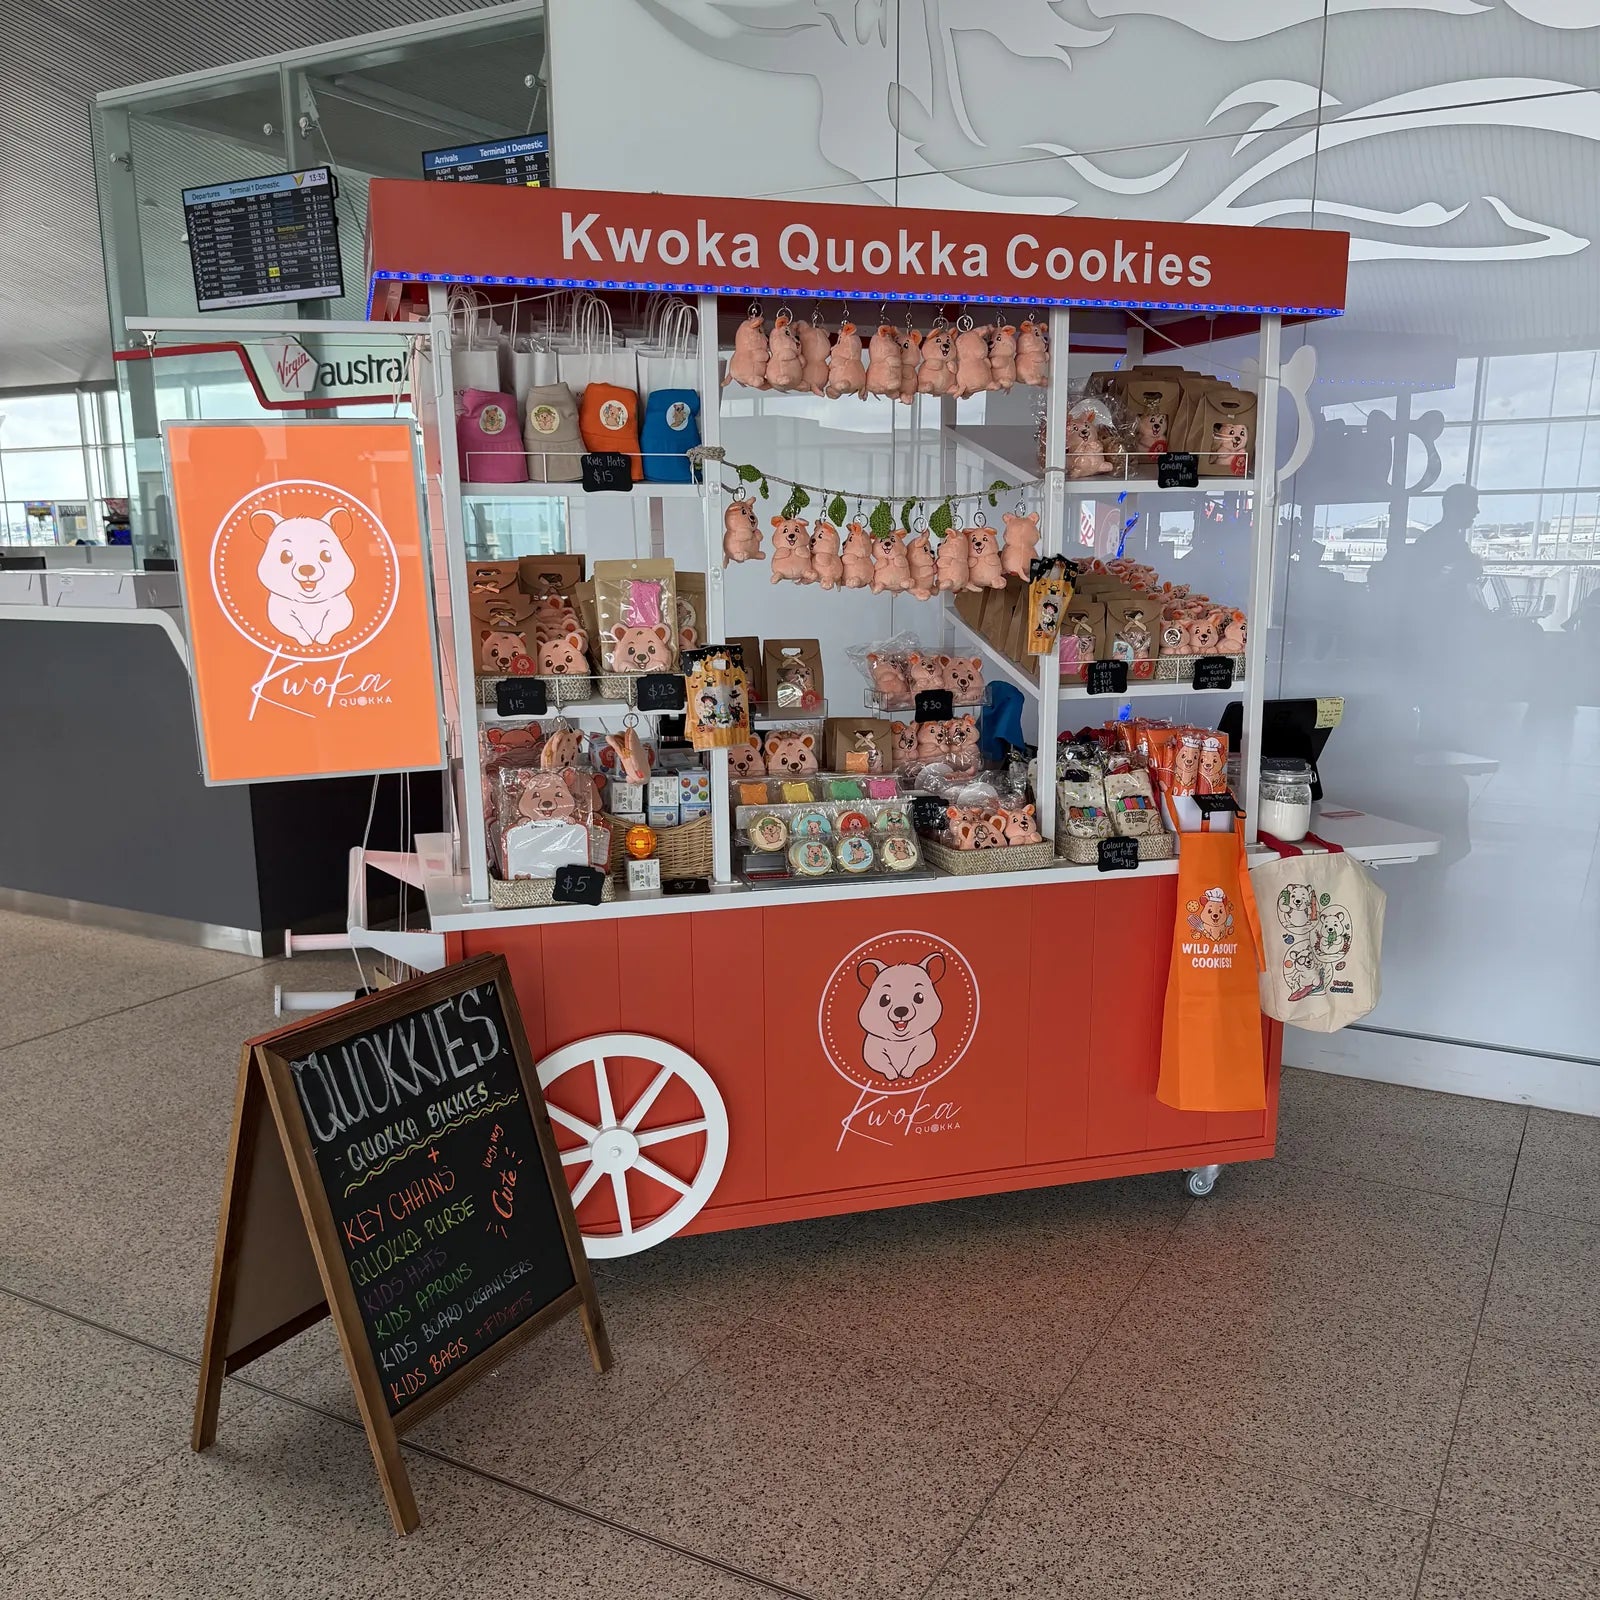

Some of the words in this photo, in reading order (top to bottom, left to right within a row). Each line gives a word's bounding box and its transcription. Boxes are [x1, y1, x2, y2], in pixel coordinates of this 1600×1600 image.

[434, 154, 459, 165] Arrivals
[480, 145, 507, 157] Terminal
[512, 140, 543, 152] Domestic
[191, 189, 220, 201] Departures
[228, 184, 250, 194] Terminal
[255, 180, 280, 190] Domestic
[309, 172, 325, 182] 13:30
[561, 210, 762, 269] Kwoka
[779, 223, 989, 278] Quokka
[1005, 231, 1213, 290] Cookies
[277, 344, 310, 389] Virgin
[586, 455, 602, 467] Kids
[607, 455, 626, 467] Hats
[593, 468, 614, 484] $15
[249, 643, 392, 721] Kwoka
[648, 683, 676, 700] $23
[339, 696, 393, 708] QUOKKA
[922, 700, 942, 711] $30
[1102, 842, 1124, 850] Colour
[561, 875, 591, 894] $5
[1182, 943, 1210, 954] WILD
[1212, 943, 1238, 954] ABOUT
[1192, 957, 1232, 968] COOKIES!
[290, 988, 500, 1143] QUOKKIES
[347, 1116, 421, 1172] QUOKKA
[426, 1080, 489, 1129] BIKKIES
[836, 1079, 962, 1152] Kwoka
[915, 1122, 962, 1135] QUOKKA
[342, 1203, 385, 1250] KEY
[388, 1165, 456, 1220] CHAINS
[492, 1169, 518, 1219] Cute
[350, 1227, 423, 1287] QUOKKA
[424, 1194, 476, 1240] PURSE
[362, 1275, 405, 1316] KIDS
[406, 1248, 449, 1286] HATS
[374, 1304, 412, 1340] KIDS
[415, 1262, 474, 1312] APRONS
[380, 1334, 419, 1373] KIDS
[421, 1303, 464, 1344] BOARD
[465, 1258, 534, 1313] ORGANISERS
[390, 1367, 428, 1405] KIDS
[429, 1336, 469, 1375] BAGS
